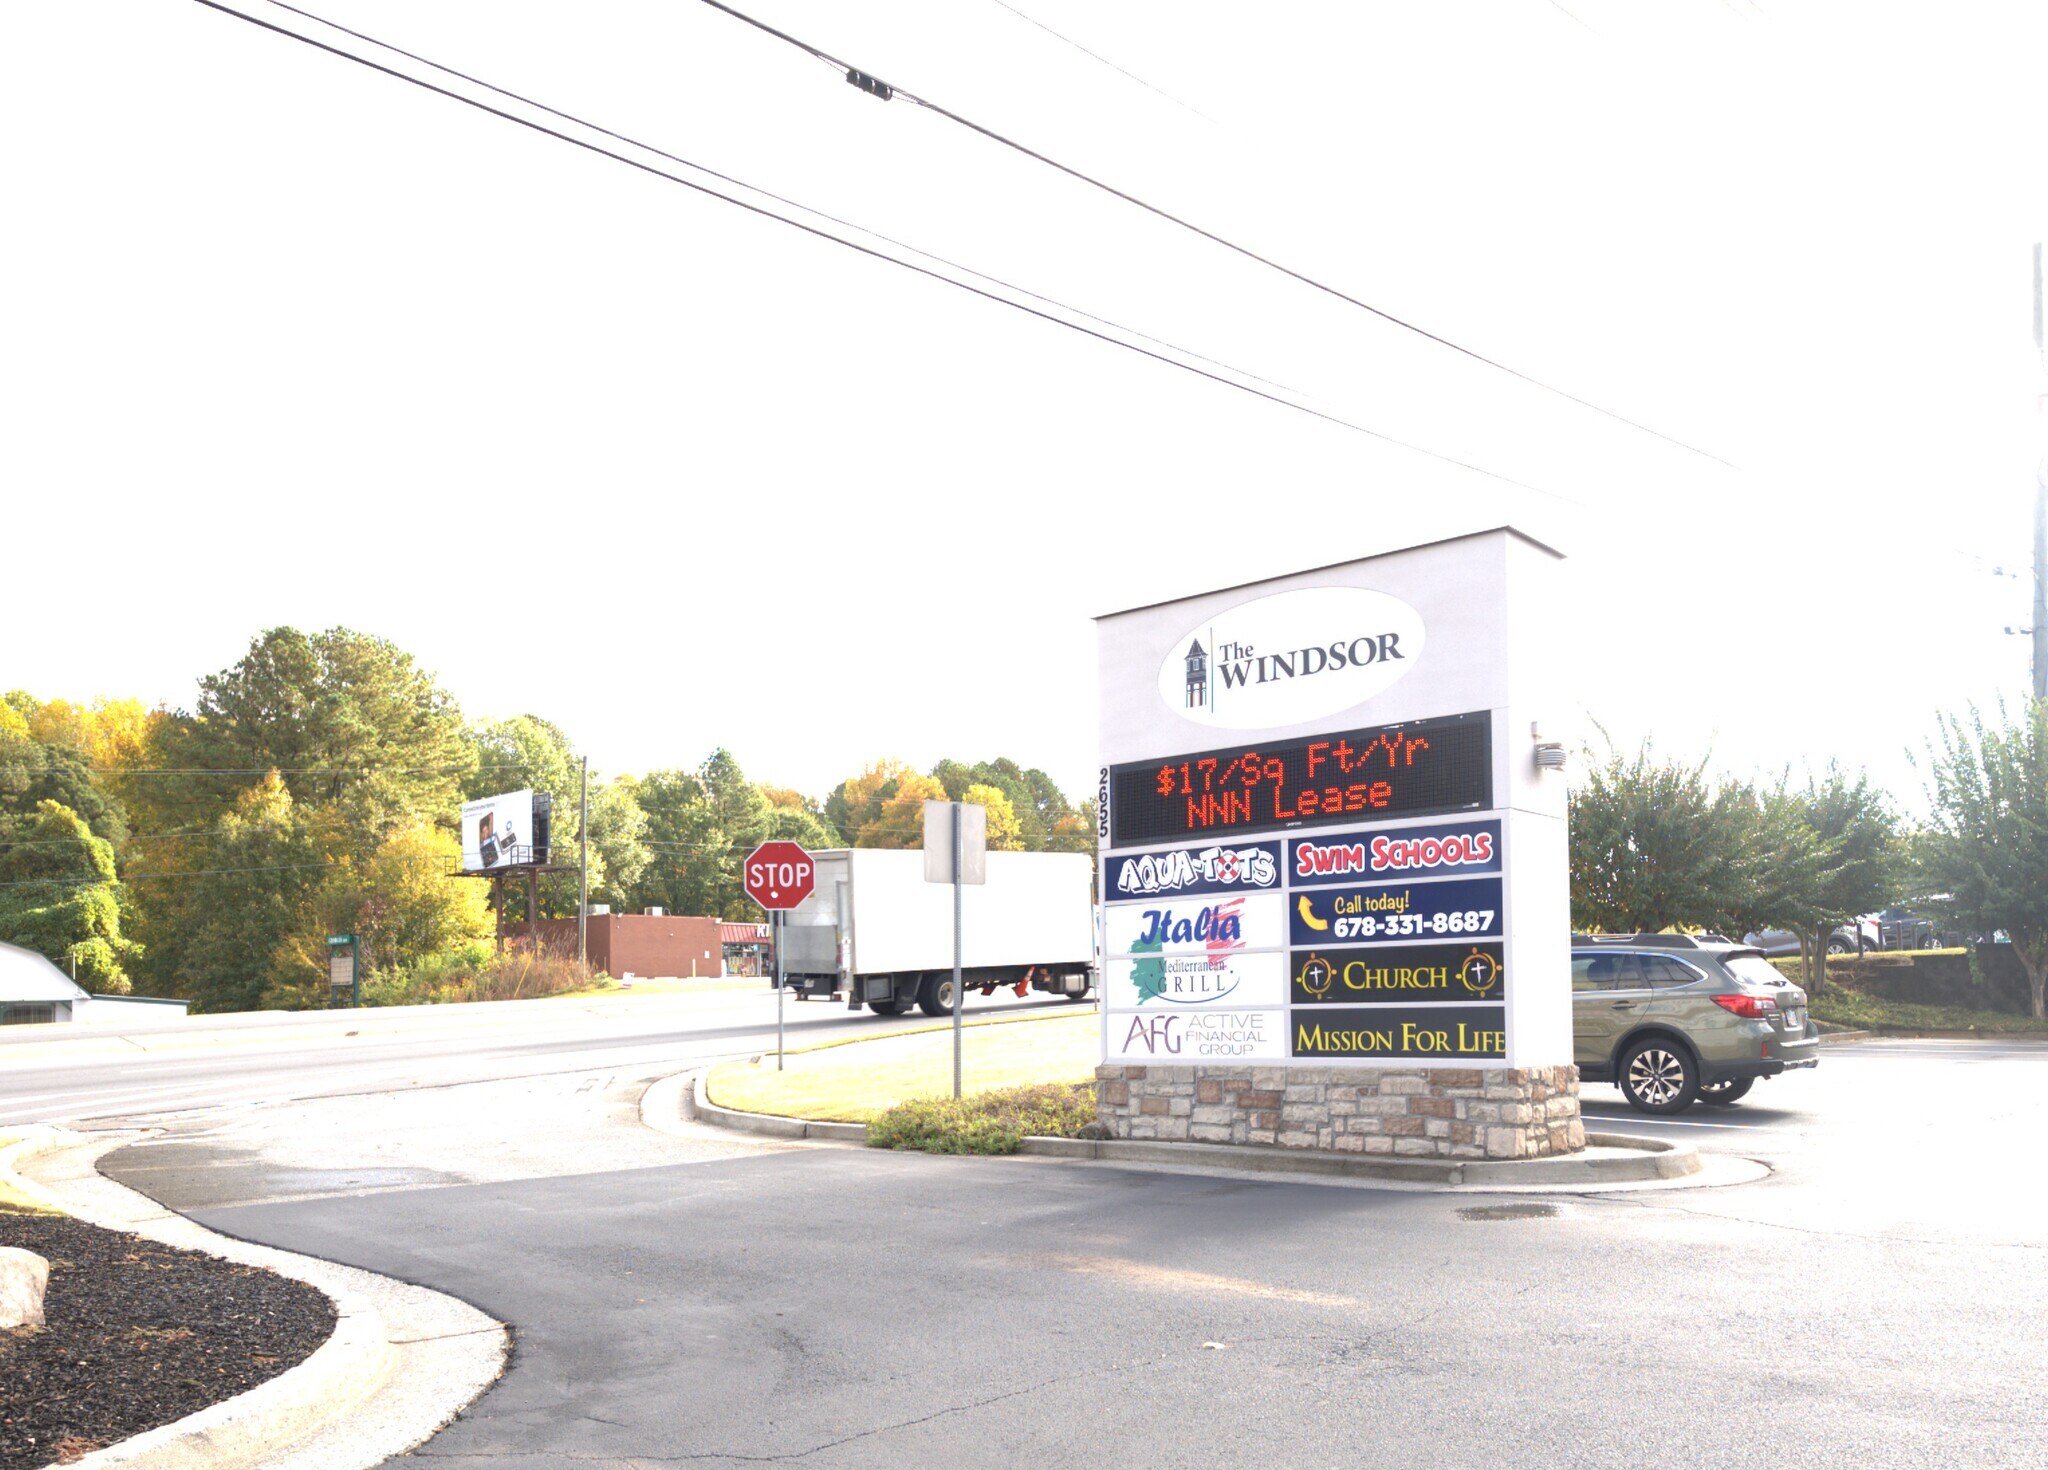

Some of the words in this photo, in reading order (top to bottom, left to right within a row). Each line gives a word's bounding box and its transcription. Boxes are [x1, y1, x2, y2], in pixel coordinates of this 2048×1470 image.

[1218, 632, 1405, 690] WINDSOR
[1219, 641, 1254, 662] The
[1157, 752, 1284, 796] $17/Sq
[1308, 732, 1429, 778] Ft/Yr
[1099, 767, 1109, 838] 2655
[1188, 789, 1251, 828] NNN
[1274, 781, 1392, 819] Lease
[1297, 842, 1365, 876] SWIM
[1370, 832, 1494, 870] SCHOOLS
[749, 862, 811, 889] STOP
[1118, 847, 1277, 894] AQUA-TOTS
[1334, 894, 1363, 915] Call
[1364, 890, 1410, 914] today!
[1141, 905, 1241, 945] Italia
[1334, 910, 1495, 938] 678-331-8687
[1158, 959, 1226, 974] Mediterranean
[1343, 961, 1448, 990] CHURCH
[1158, 974, 1226, 993] GRILL
[1122, 1015, 1181, 1054] AFG
[1185, 1030, 1268, 1042] FINANCIAL
[1188, 1014, 1264, 1029] ACTIVE
[1199, 1044, 1254, 1056] GROUP
[1296, 1023, 1393, 1051] MISSION
[1400, 1022, 1453, 1051] FOR
[1456, 1022, 1506, 1053] LIFE
